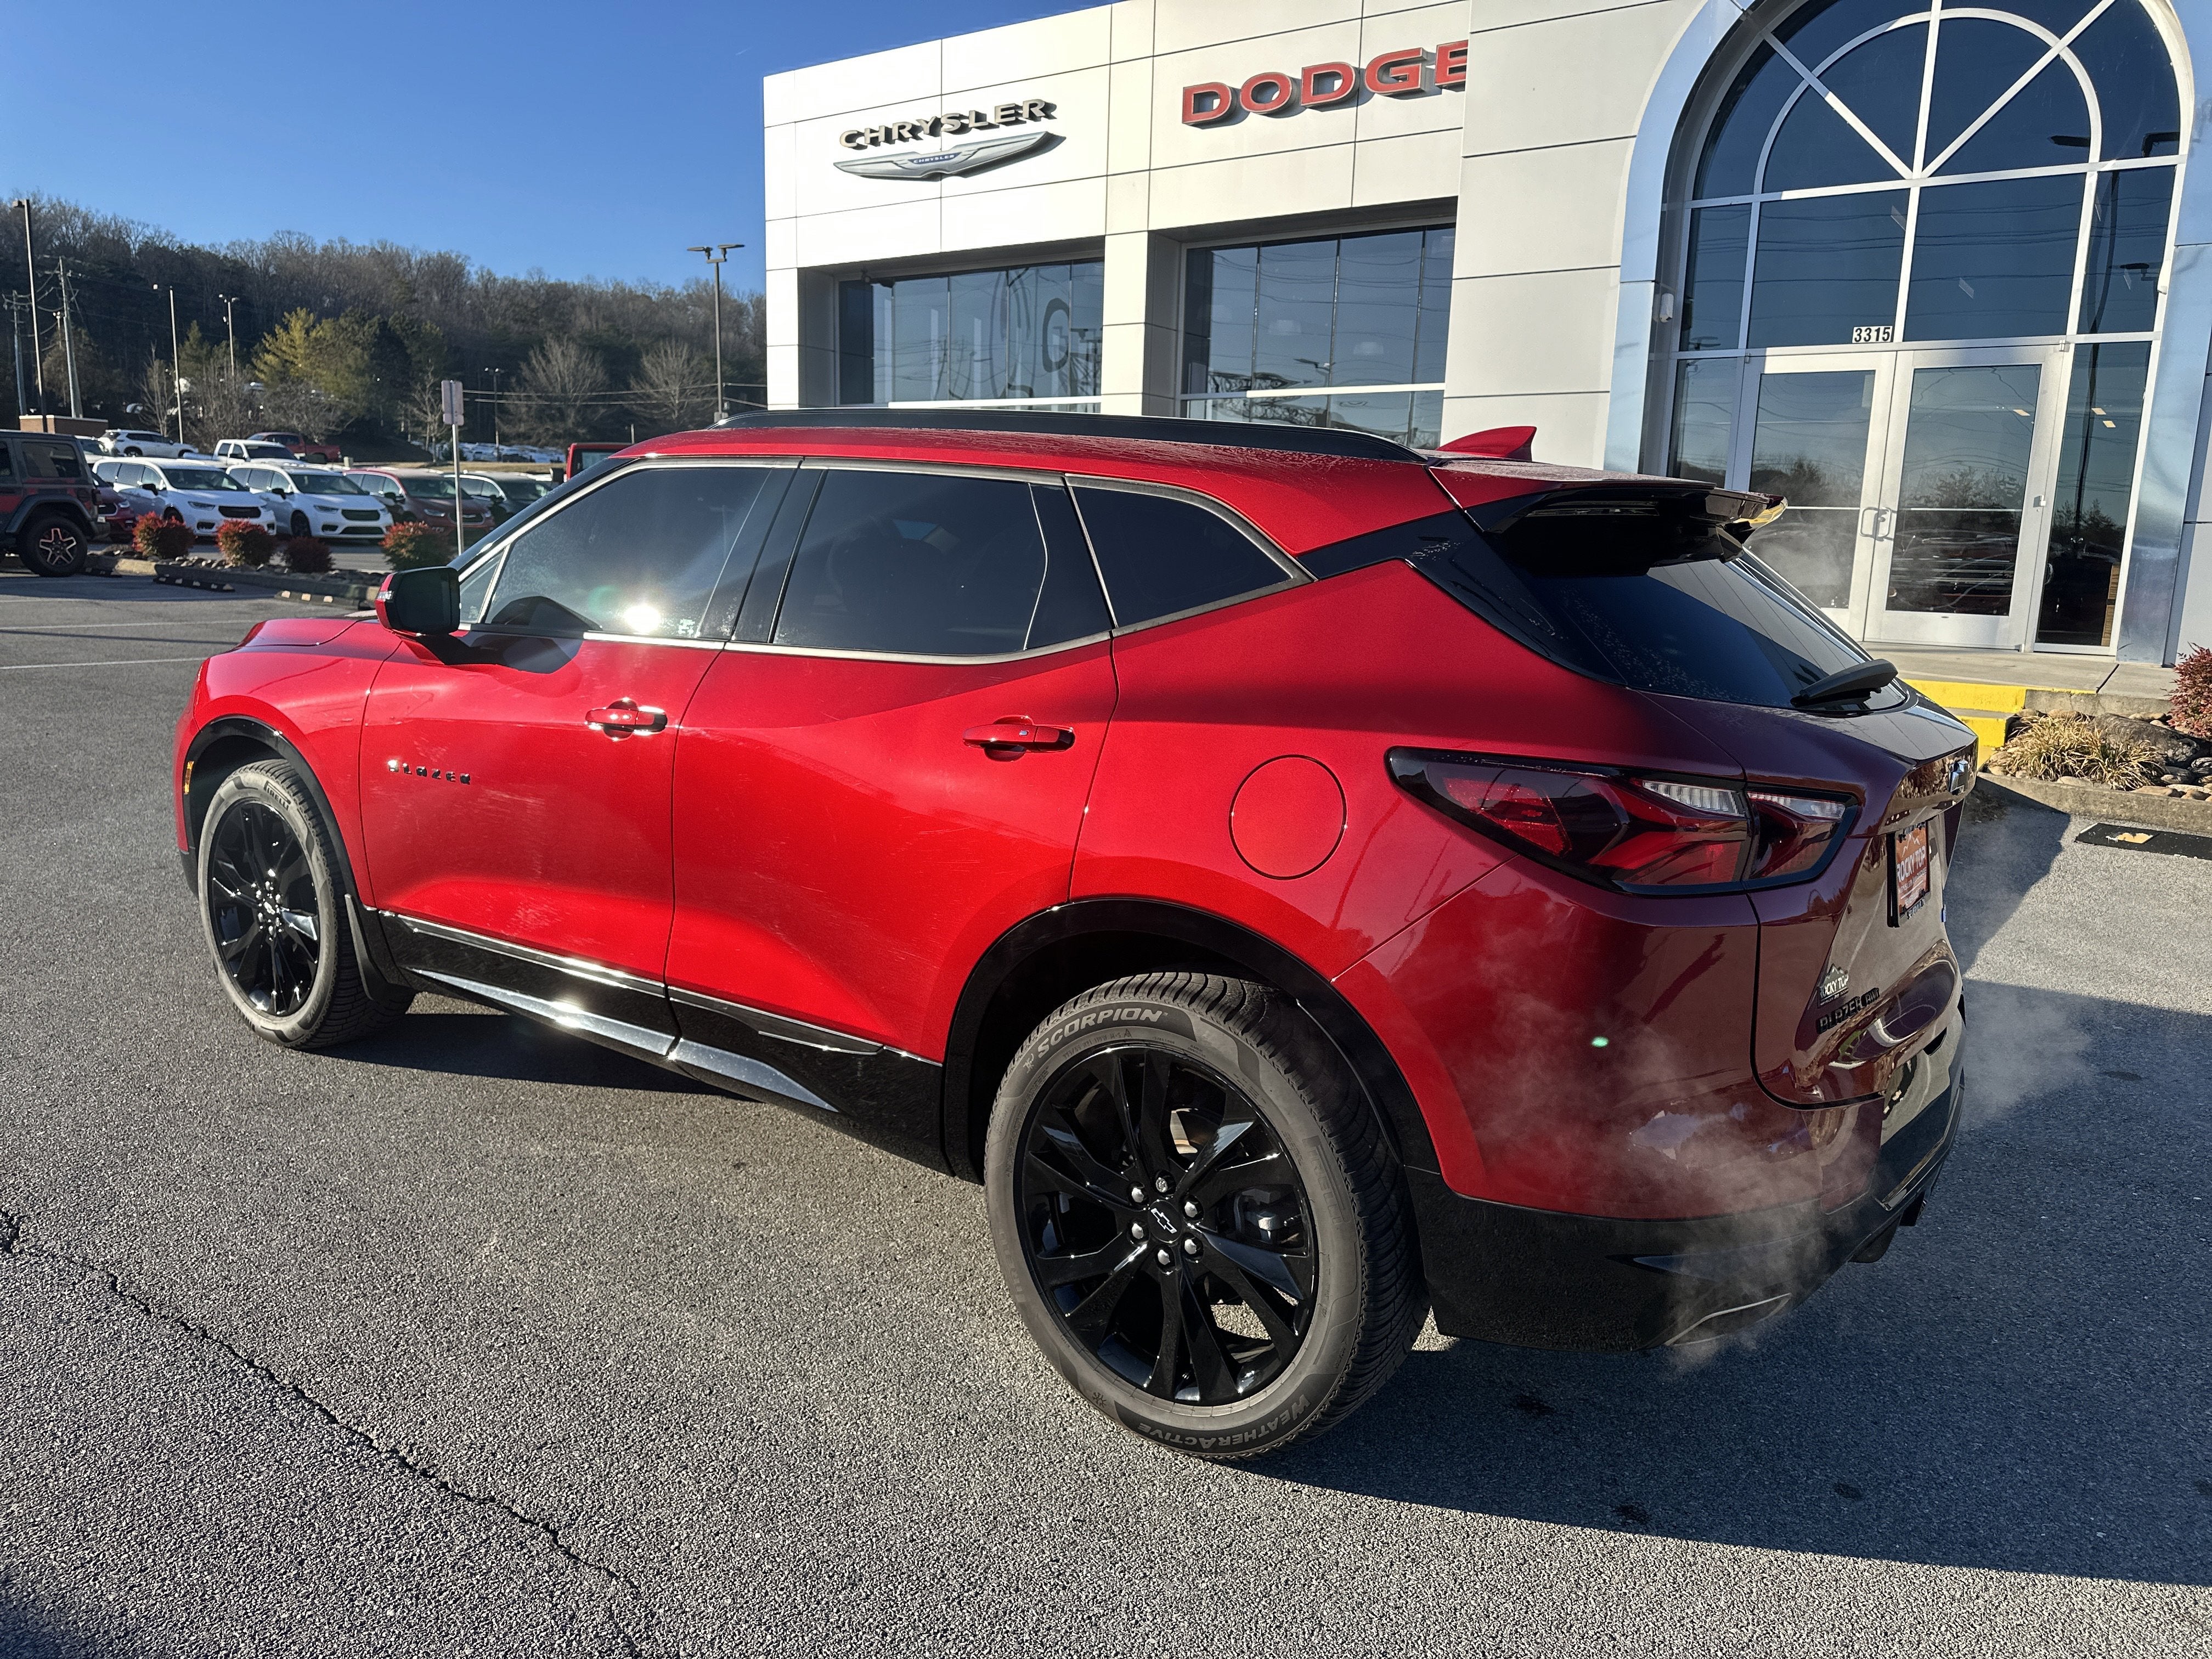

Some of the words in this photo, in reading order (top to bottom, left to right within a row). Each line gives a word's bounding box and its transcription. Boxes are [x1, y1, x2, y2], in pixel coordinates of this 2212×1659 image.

[1182, 40, 1469, 124] DODGE
[839, 99, 1049, 149] CHRYSLER
[913, 155, 955, 163] CHRYSLER
[1854, 327, 1891, 342] 3315
[1897, 855, 1915, 882] ROCKY
[1915, 845, 1926, 870] TOP
[1037, 1008, 1163, 1058] SCORPION
